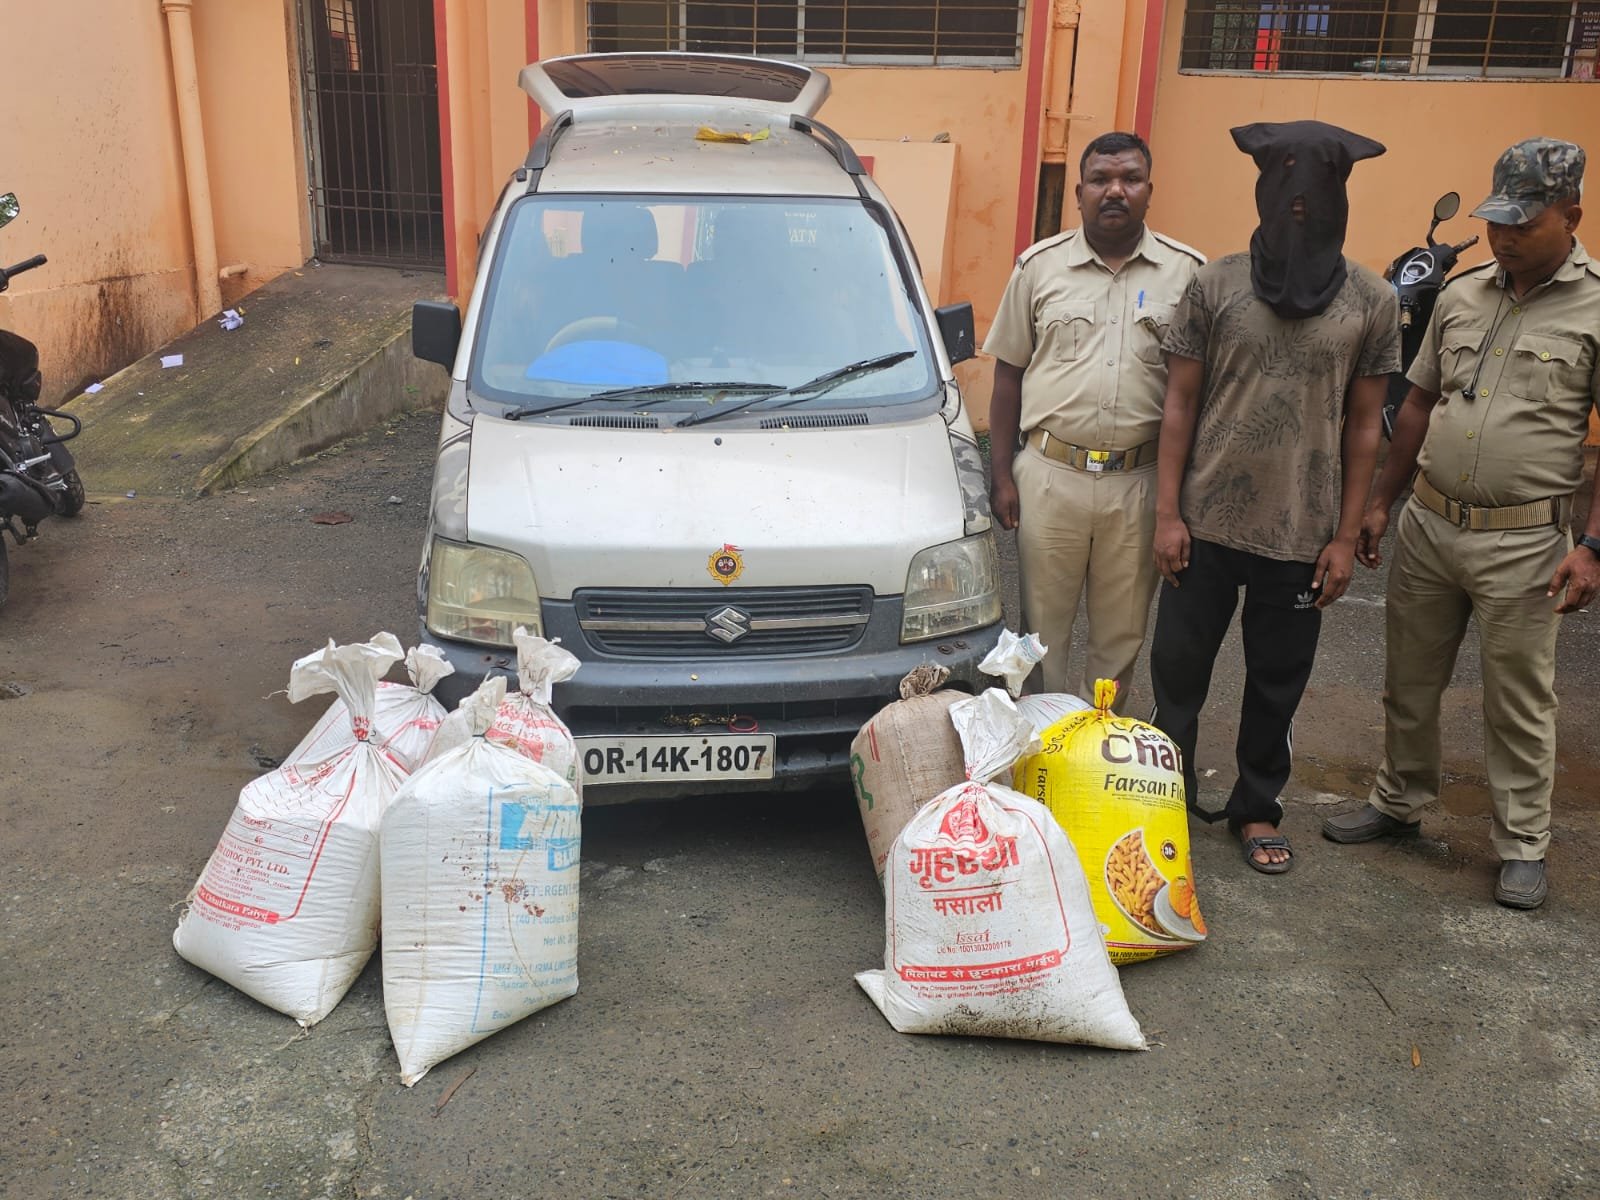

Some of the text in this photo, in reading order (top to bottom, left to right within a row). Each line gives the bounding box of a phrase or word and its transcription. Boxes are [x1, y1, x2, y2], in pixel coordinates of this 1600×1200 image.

[584, 745, 767, 775] OR-14K-1807
[1104, 774, 1167, 796] Farsan
[245, 856, 264, 869] PVT.
[267, 861, 291, 876] LTD.
[933, 891, 1004, 917] मसाला
